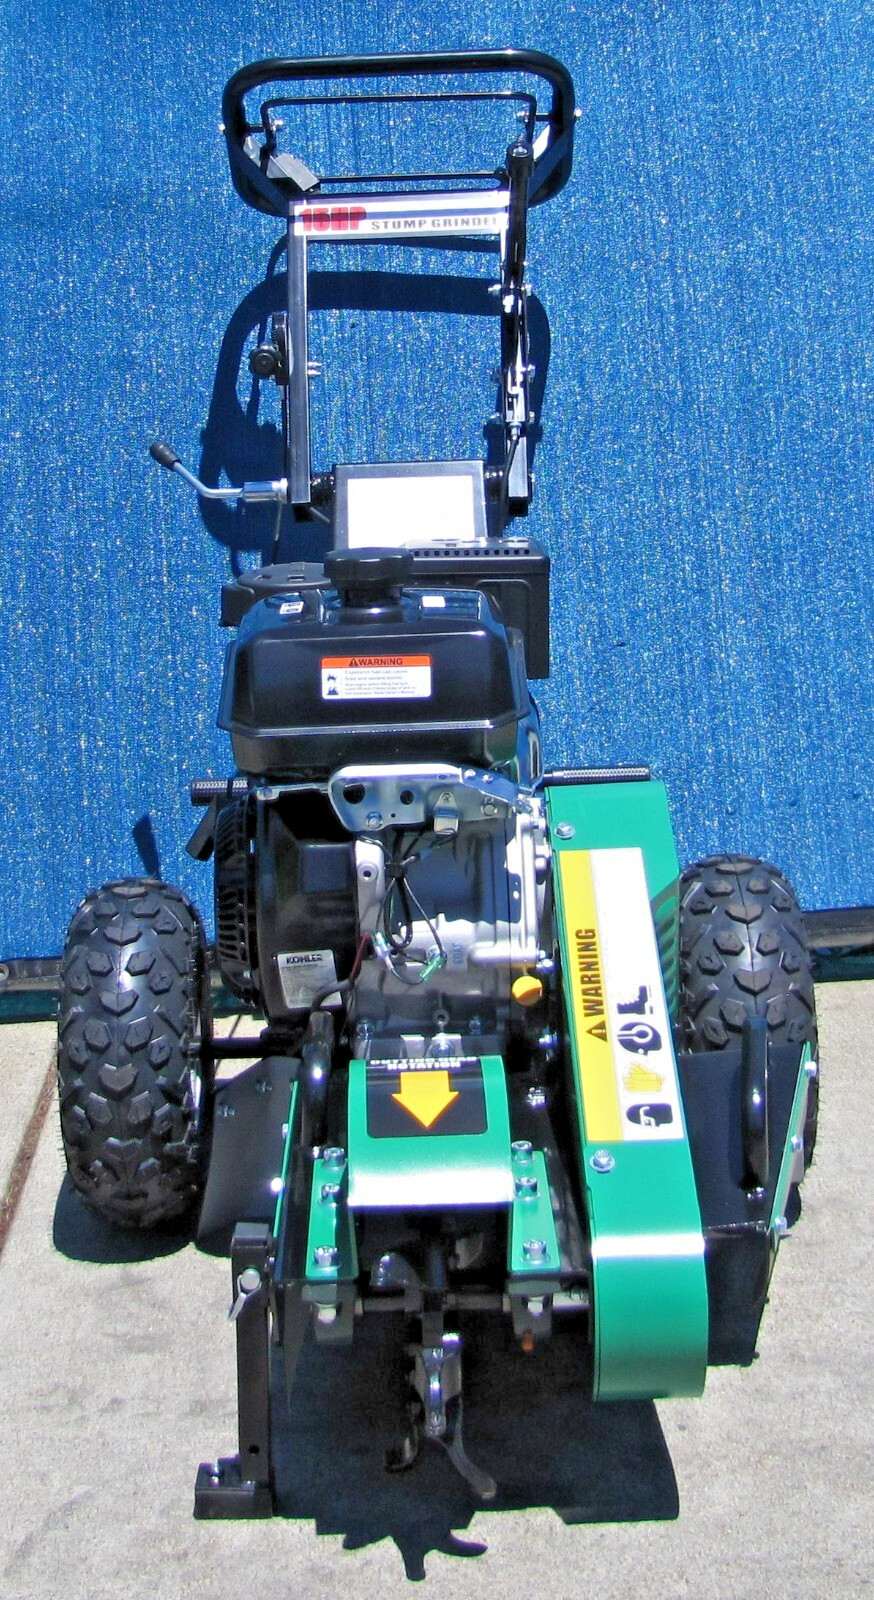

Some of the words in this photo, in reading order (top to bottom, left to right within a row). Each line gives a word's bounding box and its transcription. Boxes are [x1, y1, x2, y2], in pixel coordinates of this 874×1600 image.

[299, 206, 367, 231] 15HP
[371, 219, 427, 230] STUMP
[358, 658, 403, 666] WARNING
[286, 954, 323, 964] KOHLER
[575, 928, 605, 1018] WARNING
[387, 1061, 461, 1070] ROTATION
